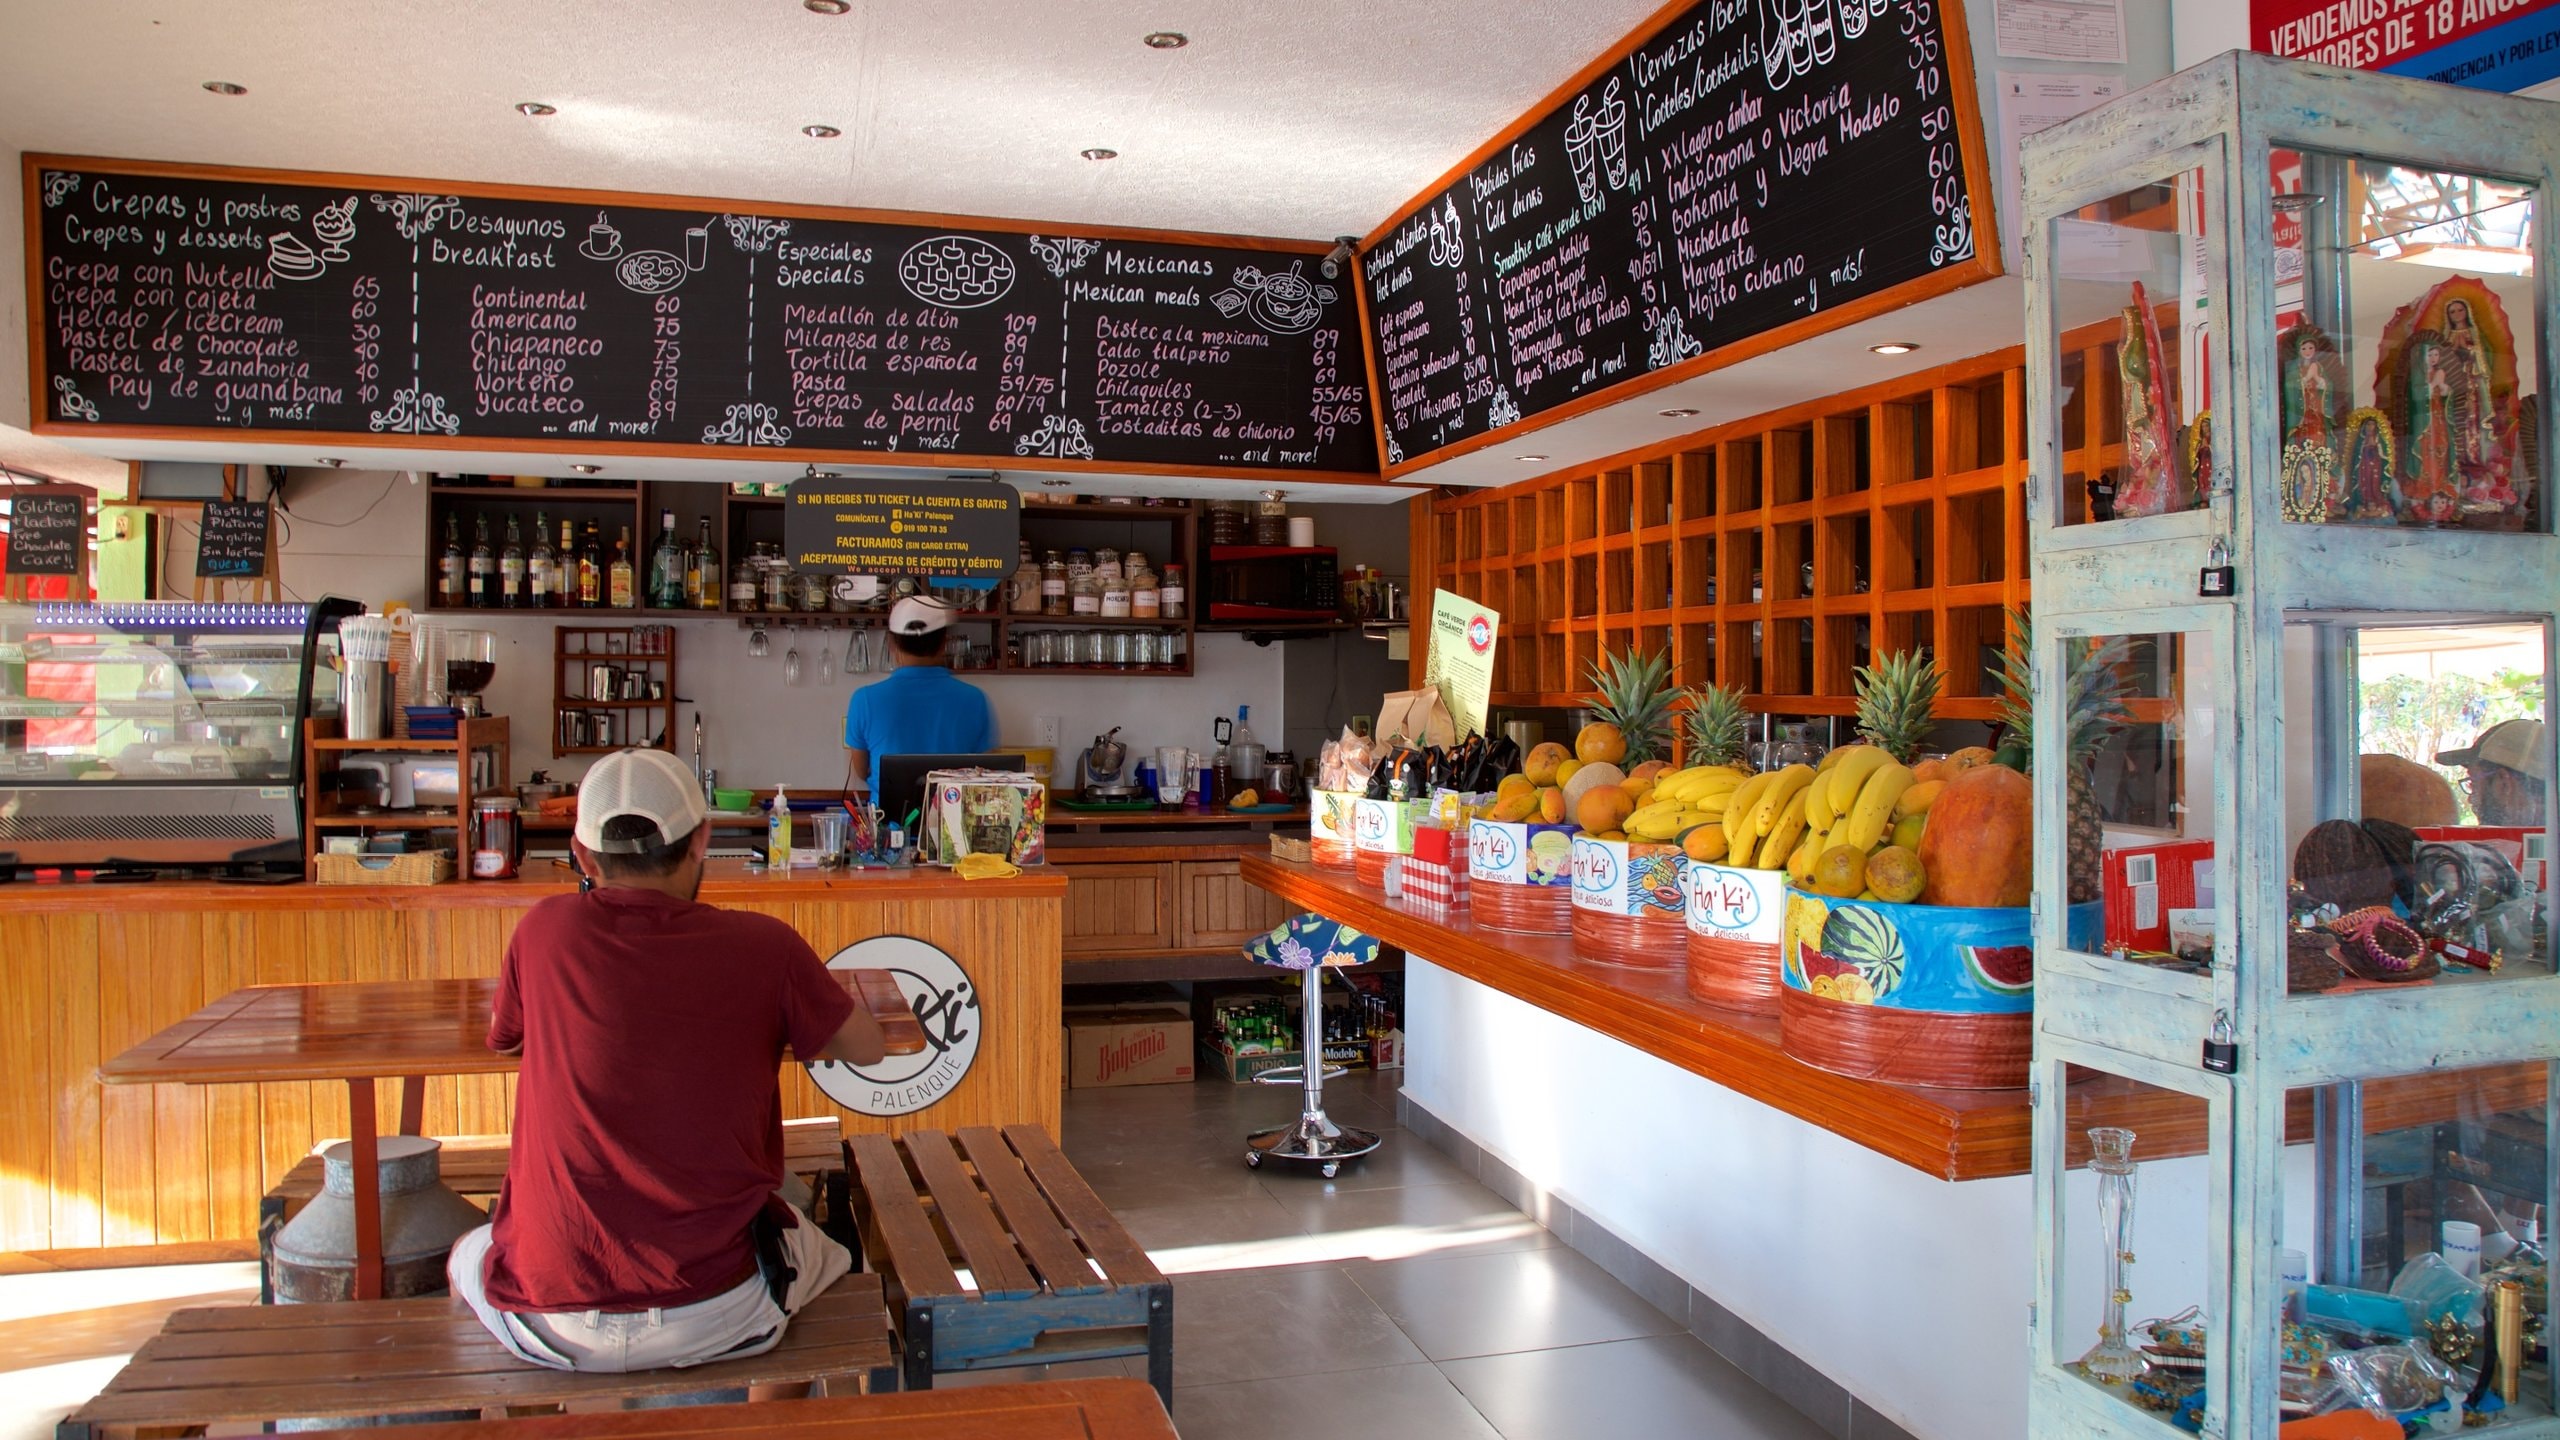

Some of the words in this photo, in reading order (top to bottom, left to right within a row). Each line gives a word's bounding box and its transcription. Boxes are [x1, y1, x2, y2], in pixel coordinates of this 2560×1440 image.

[2385, 13, 2414, 56] DE
[2425, 0, 2454, 40] 18
[2498, 48, 2506, 66] Y
[2510, 39, 2534, 63] POR
[2538, 29, 2560, 54] LEY
[1672, 181, 1739, 236] Bohemia
[1756, 168, 1768, 208] y
[1779, 135, 1828, 177] Negra
[1840, 95, 1900, 143] Modelo
[1915, 66, 1939, 101] 40
[1677, 208, 1750, 263] Michelada
[1921, 105, 1949, 141] 50
[93, 181, 186, 220] Crepas
[199, 197, 210, 227] y
[224, 194, 301, 226] postres
[1485, 201, 1505, 232] Cold
[1682, 241, 1755, 291] Margarita
[1929, 142, 1954, 178] 60
[65, 214, 143, 251] Crepes
[153, 230, 166, 255] y
[179, 227, 263, 249] desserts
[450, 208, 566, 247] Desayunos
[433, 238, 556, 269] Breakfast
[777, 240, 872, 268] Especiales
[1499, 264, 1541, 300] Capuchino
[1542, 255, 1557, 275] con
[1632, 201, 1648, 225] 50
[1688, 274, 1737, 321] Mojito
[1744, 254, 1805, 292] cubano
[1932, 175, 1957, 215] 60
[1106, 250, 1214, 275] Mexicanas
[50, 256, 119, 284] Crepa
[134, 264, 173, 285] con
[185, 261, 276, 290] Nutella
[352, 276, 380, 299] 65
[777, 264, 865, 288] Specials
[1456, 271, 1468, 293] 20
[472, 284, 587, 311] Continental
[655, 295, 680, 314] 60
[1073, 280, 1145, 302] Mexican
[1155, 282, 1200, 306] meals
[1376, 277, 1390, 303] Hot
[1511, 322, 1563, 366] Chamoyada
[1641, 280, 1656, 302] 45
[471, 330, 603, 358] Chiapaneco
[654, 339, 681, 361] 75
[785, 328, 877, 350] Milanesa
[886, 329, 909, 350] de
[921, 338, 951, 351] res
[1004, 335, 1027, 353] 89
[70, 349, 141, 373] Pastel
[159, 352, 185, 375] de
[355, 364, 379, 380] 40
[472, 352, 566, 377] Chilango
[654, 361, 678, 378] 75
[786, 348, 867, 371] Tortilla
[886, 351, 978, 375] española
[1003, 355, 1024, 373] 69
[1097, 341, 1141, 359] Caldo
[1153, 343, 1230, 365] tlalpeño
[1313, 350, 1336, 366] 69
[792, 372, 846, 392] Pasta
[1000, 375, 1055, 393] 59/75
[1098, 361, 1160, 378] Pozole
[1315, 368, 1336, 383] 69
[109, 374, 152, 410] Pay
[170, 375, 199, 399] de
[216, 379, 342, 412] guanábana
[356, 385, 379, 403] 40
[475, 371, 573, 394] Norteño
[650, 380, 678, 401] 89
[1096, 379, 1192, 402] Chilaquiles
[1313, 387, 1363, 403] 55/65
[17, 499, 75, 514] Gluten
[208, 503, 247, 517] Pastel
[252, 507, 265, 517] de
[797, 494, 808, 505] SI
[809, 494, 822, 505] NO
[824, 494, 862, 505] RECIBES
[864, 494, 877, 505] TU
[879, 494, 910, 505] TICKET
[912, 496, 924, 506] LA
[926, 497, 961, 508] CUENTA
[963, 498, 975, 508] ES
[976, 499, 1008, 510] GRATIS
[835, 513, 879, 523] COMUNÍCATE
[880, 514, 886, 523] A
[904, 524, 915, 533] 919
[916, 525, 928, 533] 100
[929, 525, 937, 533] 78
[925, 511, 954, 521] Palenque
[13, 540, 72, 551] Chocolate
[14, 529, 41, 540] Free
[204, 530, 223, 541] Sin
[836, 537, 903, 549] FACTURAMOS
[905, 541, 919, 552] (SIN
[921, 542, 943, 551] CARGO
[944, 542, 969, 552] EXTRA)
[202, 545, 222, 556] Sin
[800, 554, 857, 566] ¡ACEPTAMOS
[860, 555, 904, 566] TARJETAS
[906, 556, 918, 566] DE
[920, 555, 958, 568] CRÉDITO
[960, 558, 966, 567] Y
[968, 556, 1003, 568] DÉBITO!
[847, 566, 861, 574] We
[868, 567, 900, 575] accept
[1438, 610, 1450, 620] CAFÉ
[1450, 614, 1466, 627] VERDE
[1438, 620, 1463, 635] ORGÁNICO
[1714, 927, 1750, 941] deliciosa
[1096, 1031, 1166, 1082] Bohemia
[1251, 1058, 1287, 1071] INDIO
[1325, 1048, 1357, 1060] Modelo
[871, 1056, 961, 1108] PALENQUE
